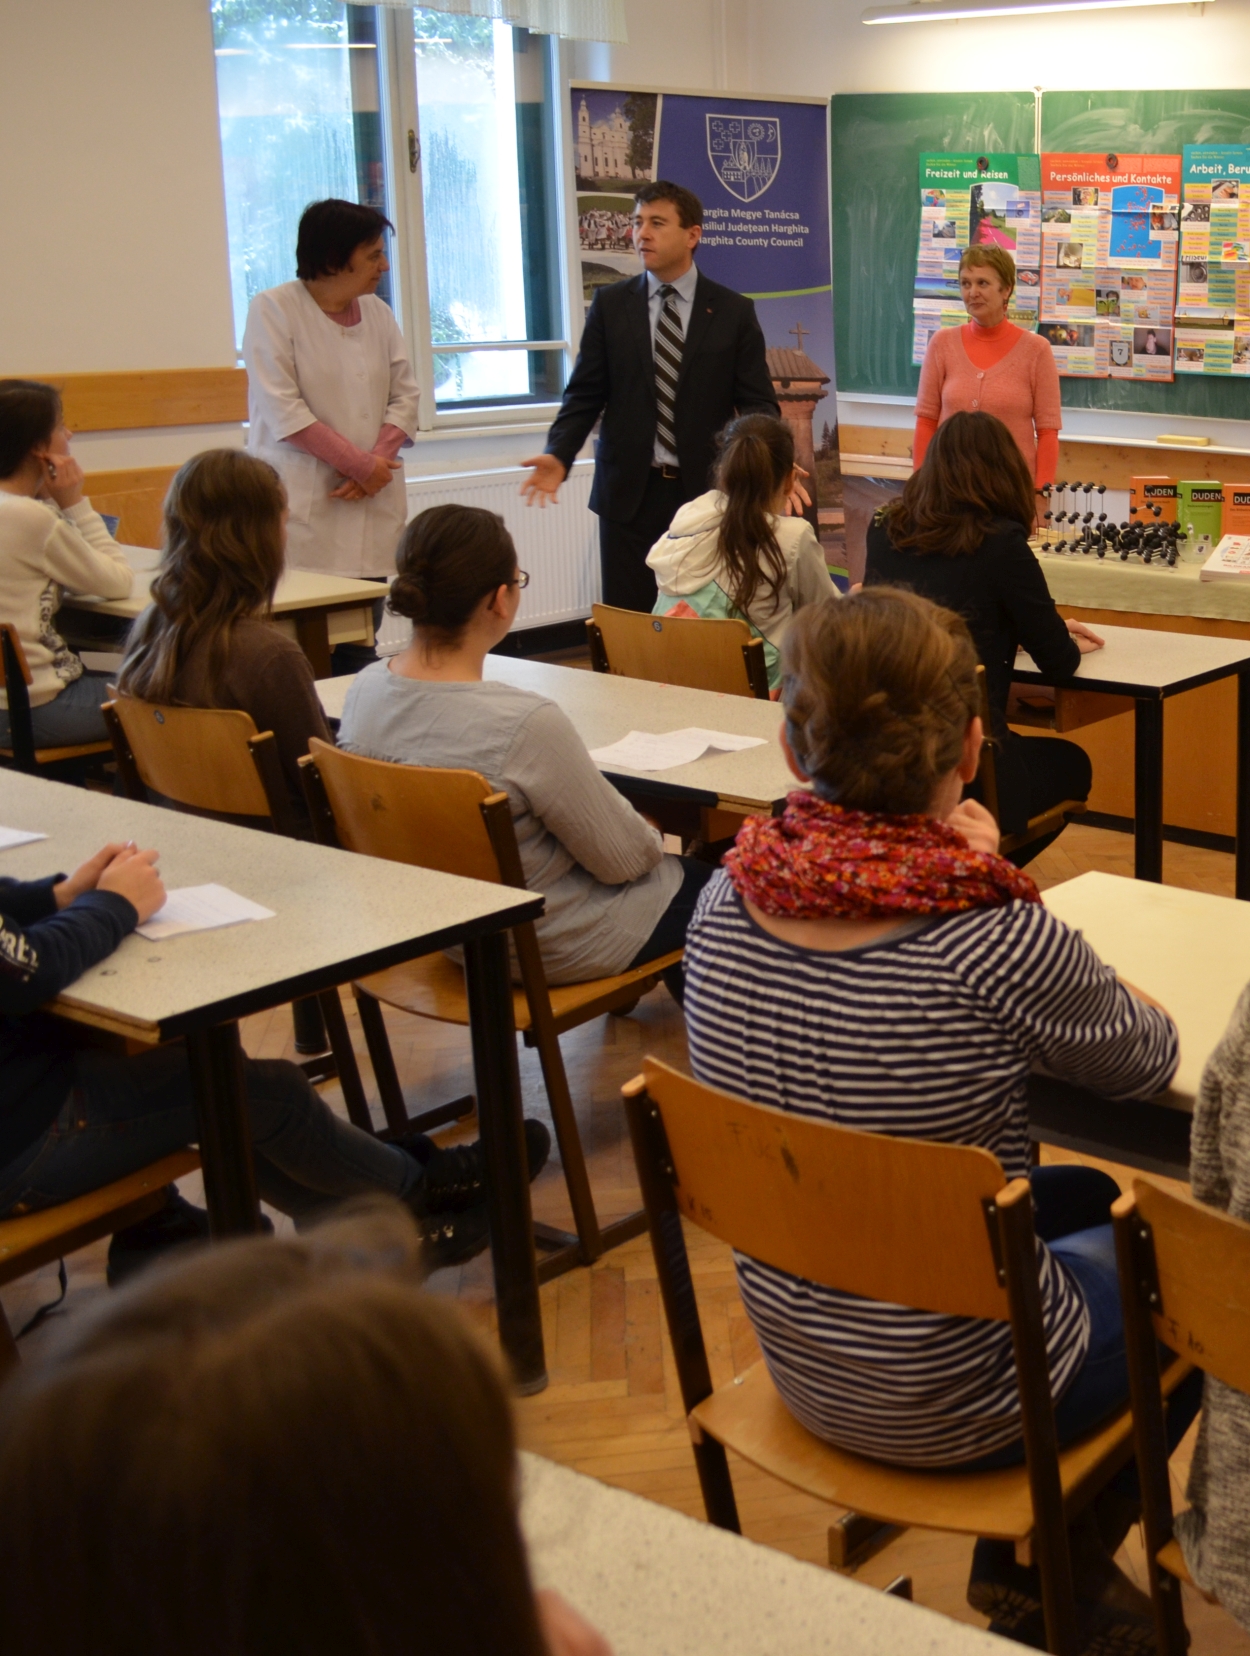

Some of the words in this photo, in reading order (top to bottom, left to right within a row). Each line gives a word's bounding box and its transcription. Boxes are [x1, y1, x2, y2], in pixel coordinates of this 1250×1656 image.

[925, 168, 961, 179] Freizeit
[963, 170, 978, 179] und
[980, 170, 1009, 179] Reisen
[1189, 163, 1226, 176] Arbeit,
[1050, 171, 1111, 183] Persönliches
[1112, 173, 1129, 183] und
[1130, 173, 1172, 184] Kontakte
[703, 208, 729, 219] argita
[731, 209, 763, 220] Megye
[764, 209, 800, 220] Tanácsa
[701, 221, 726, 232] siliul
[771, 224, 810, 235] Harghita
[735, 236, 769, 248] County
[770, 237, 804, 247] Council
[1192, 492, 1221, 500] DUDEN
